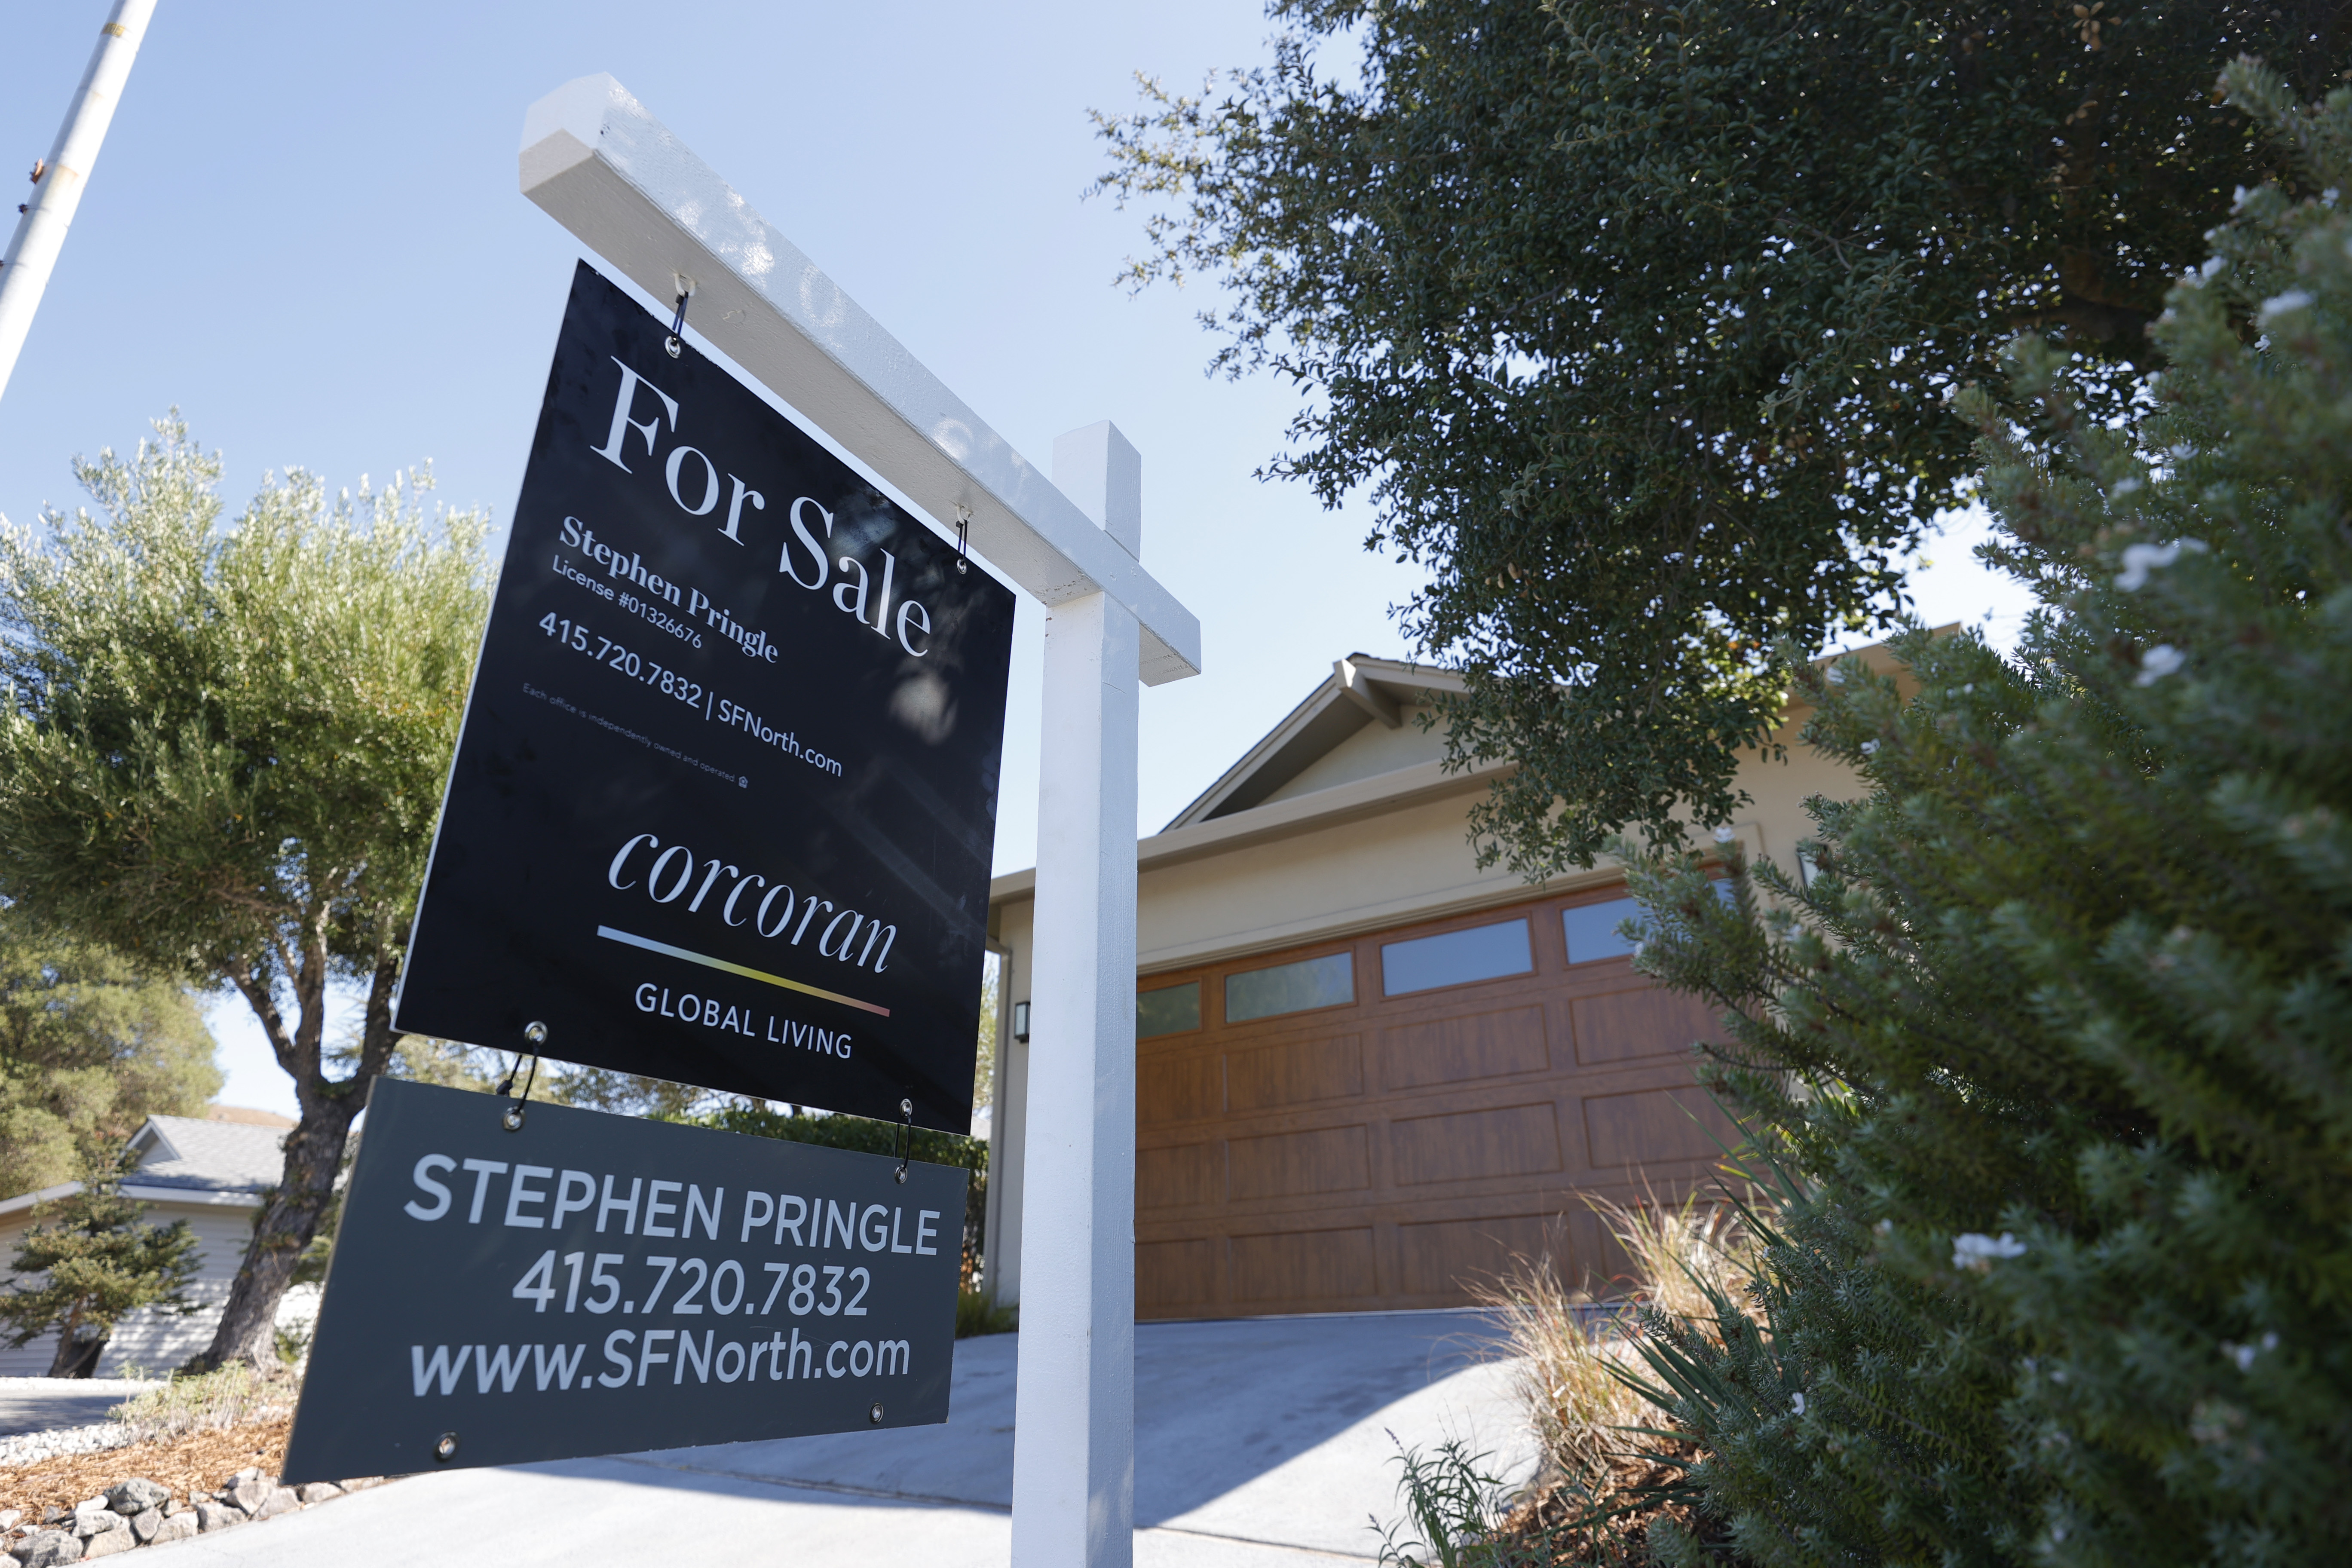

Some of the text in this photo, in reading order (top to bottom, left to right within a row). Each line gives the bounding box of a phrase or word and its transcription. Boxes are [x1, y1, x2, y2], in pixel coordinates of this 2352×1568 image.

[590, 355, 931, 657] For Sale
[552, 554, 701, 649] License #01326676
[559, 516, 778, 663] Stephen Pringle
[523, 682, 547, 700] Each
[549, 697, 577, 714] office
[579, 709, 587, 718] is
[588, 713, 652, 748] independently
[653, 743, 682, 759] owned
[683, 755, 698, 766] and
[539, 612, 702, 708] 415.720.7832
[718, 699, 842, 777] SFNorth.com
[609, 834, 896, 973] corcoran
[635, 983, 851, 1059] GLOBAL LIVING
[404, 1154, 940, 1256] STEPHEN PRINGLE
[513, 1250, 870, 1316] 415.720.7832
[411, 1328, 910, 1396] www.SFNorth.com
